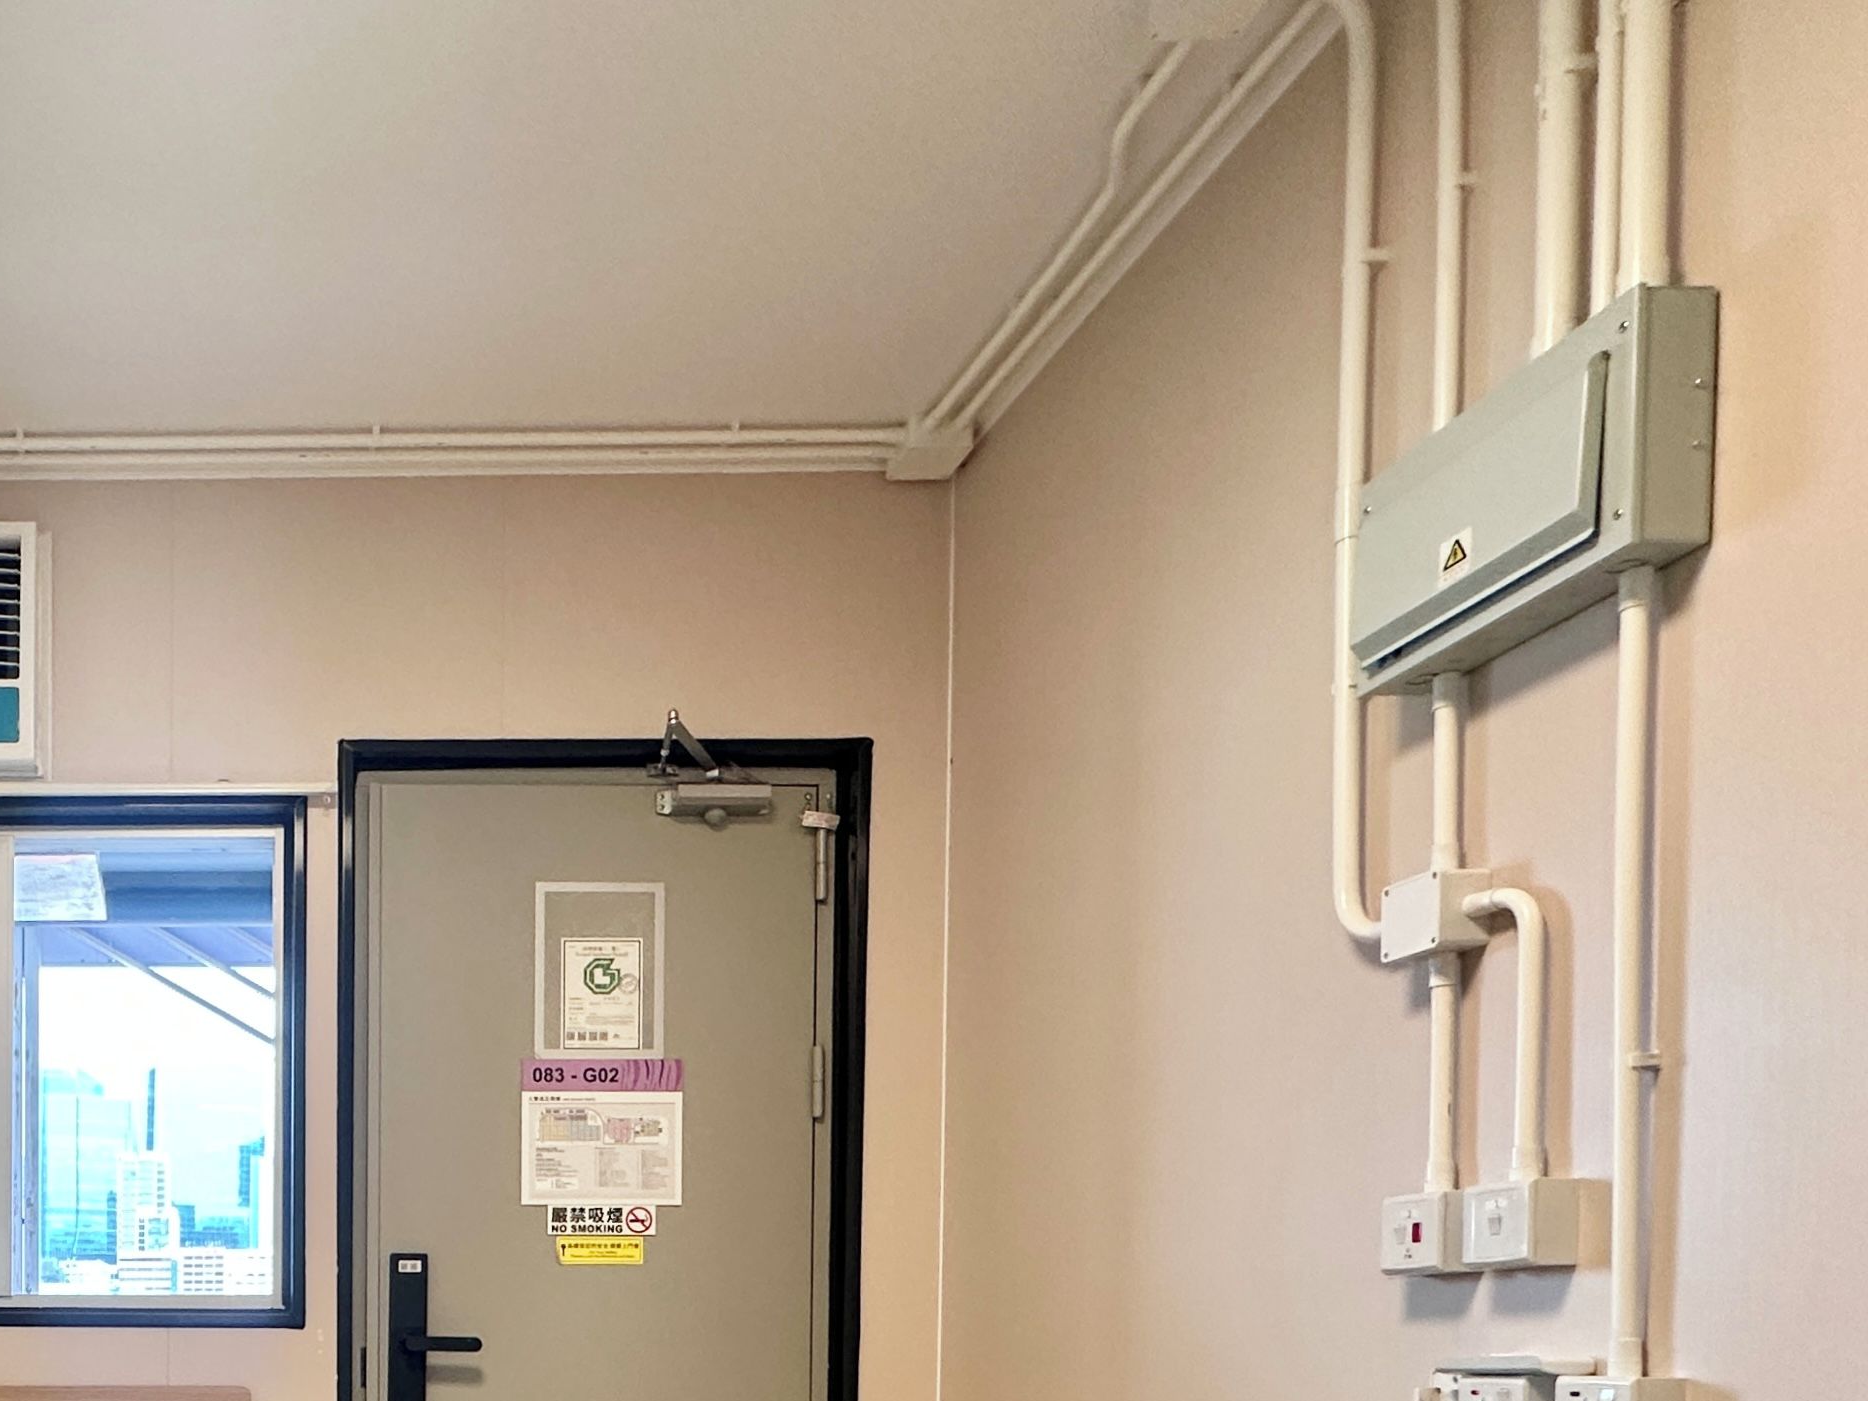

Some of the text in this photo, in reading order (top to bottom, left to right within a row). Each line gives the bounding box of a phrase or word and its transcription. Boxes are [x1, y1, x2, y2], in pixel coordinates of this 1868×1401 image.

[532, 1067, 565, 1083] 083
[583, 1067, 620, 1083] G02
[551, 1207, 623, 1223] 嚴禁吸煙
[551, 1224, 623, 1233] NO SMOKING
